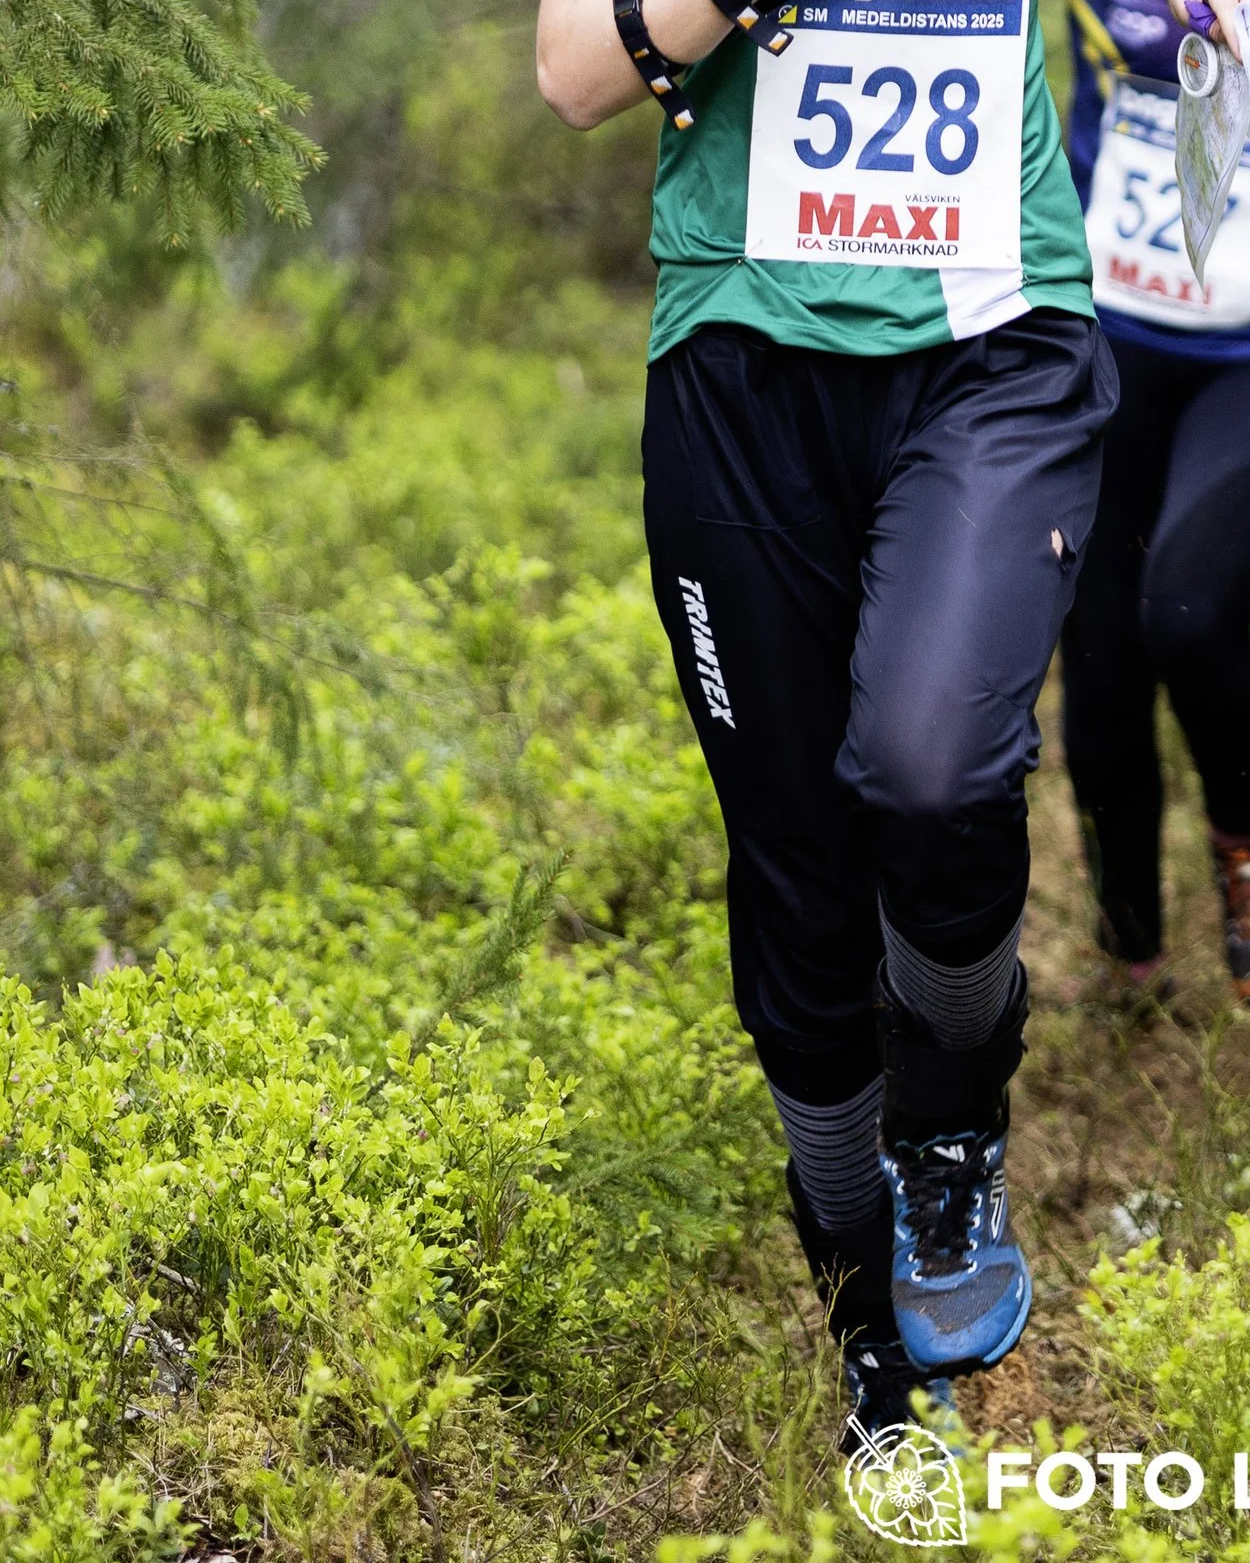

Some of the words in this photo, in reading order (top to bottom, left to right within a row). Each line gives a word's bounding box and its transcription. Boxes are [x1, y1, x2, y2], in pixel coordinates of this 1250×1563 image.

[803, 7, 828, 23] SM
[841, 9, 967, 29] MEDELDISTANS
[970, 13, 1004, 29] 2025
[793, 63, 980, 176] 528
[798, 190, 960, 242] MAXI
[904, 193, 961, 204] VÄLSVIKEN
[797, 237, 823, 250] ICA
[827, 239, 959, 257] STORMARKNAD
[677, 575, 737, 730] TRIMTEX
